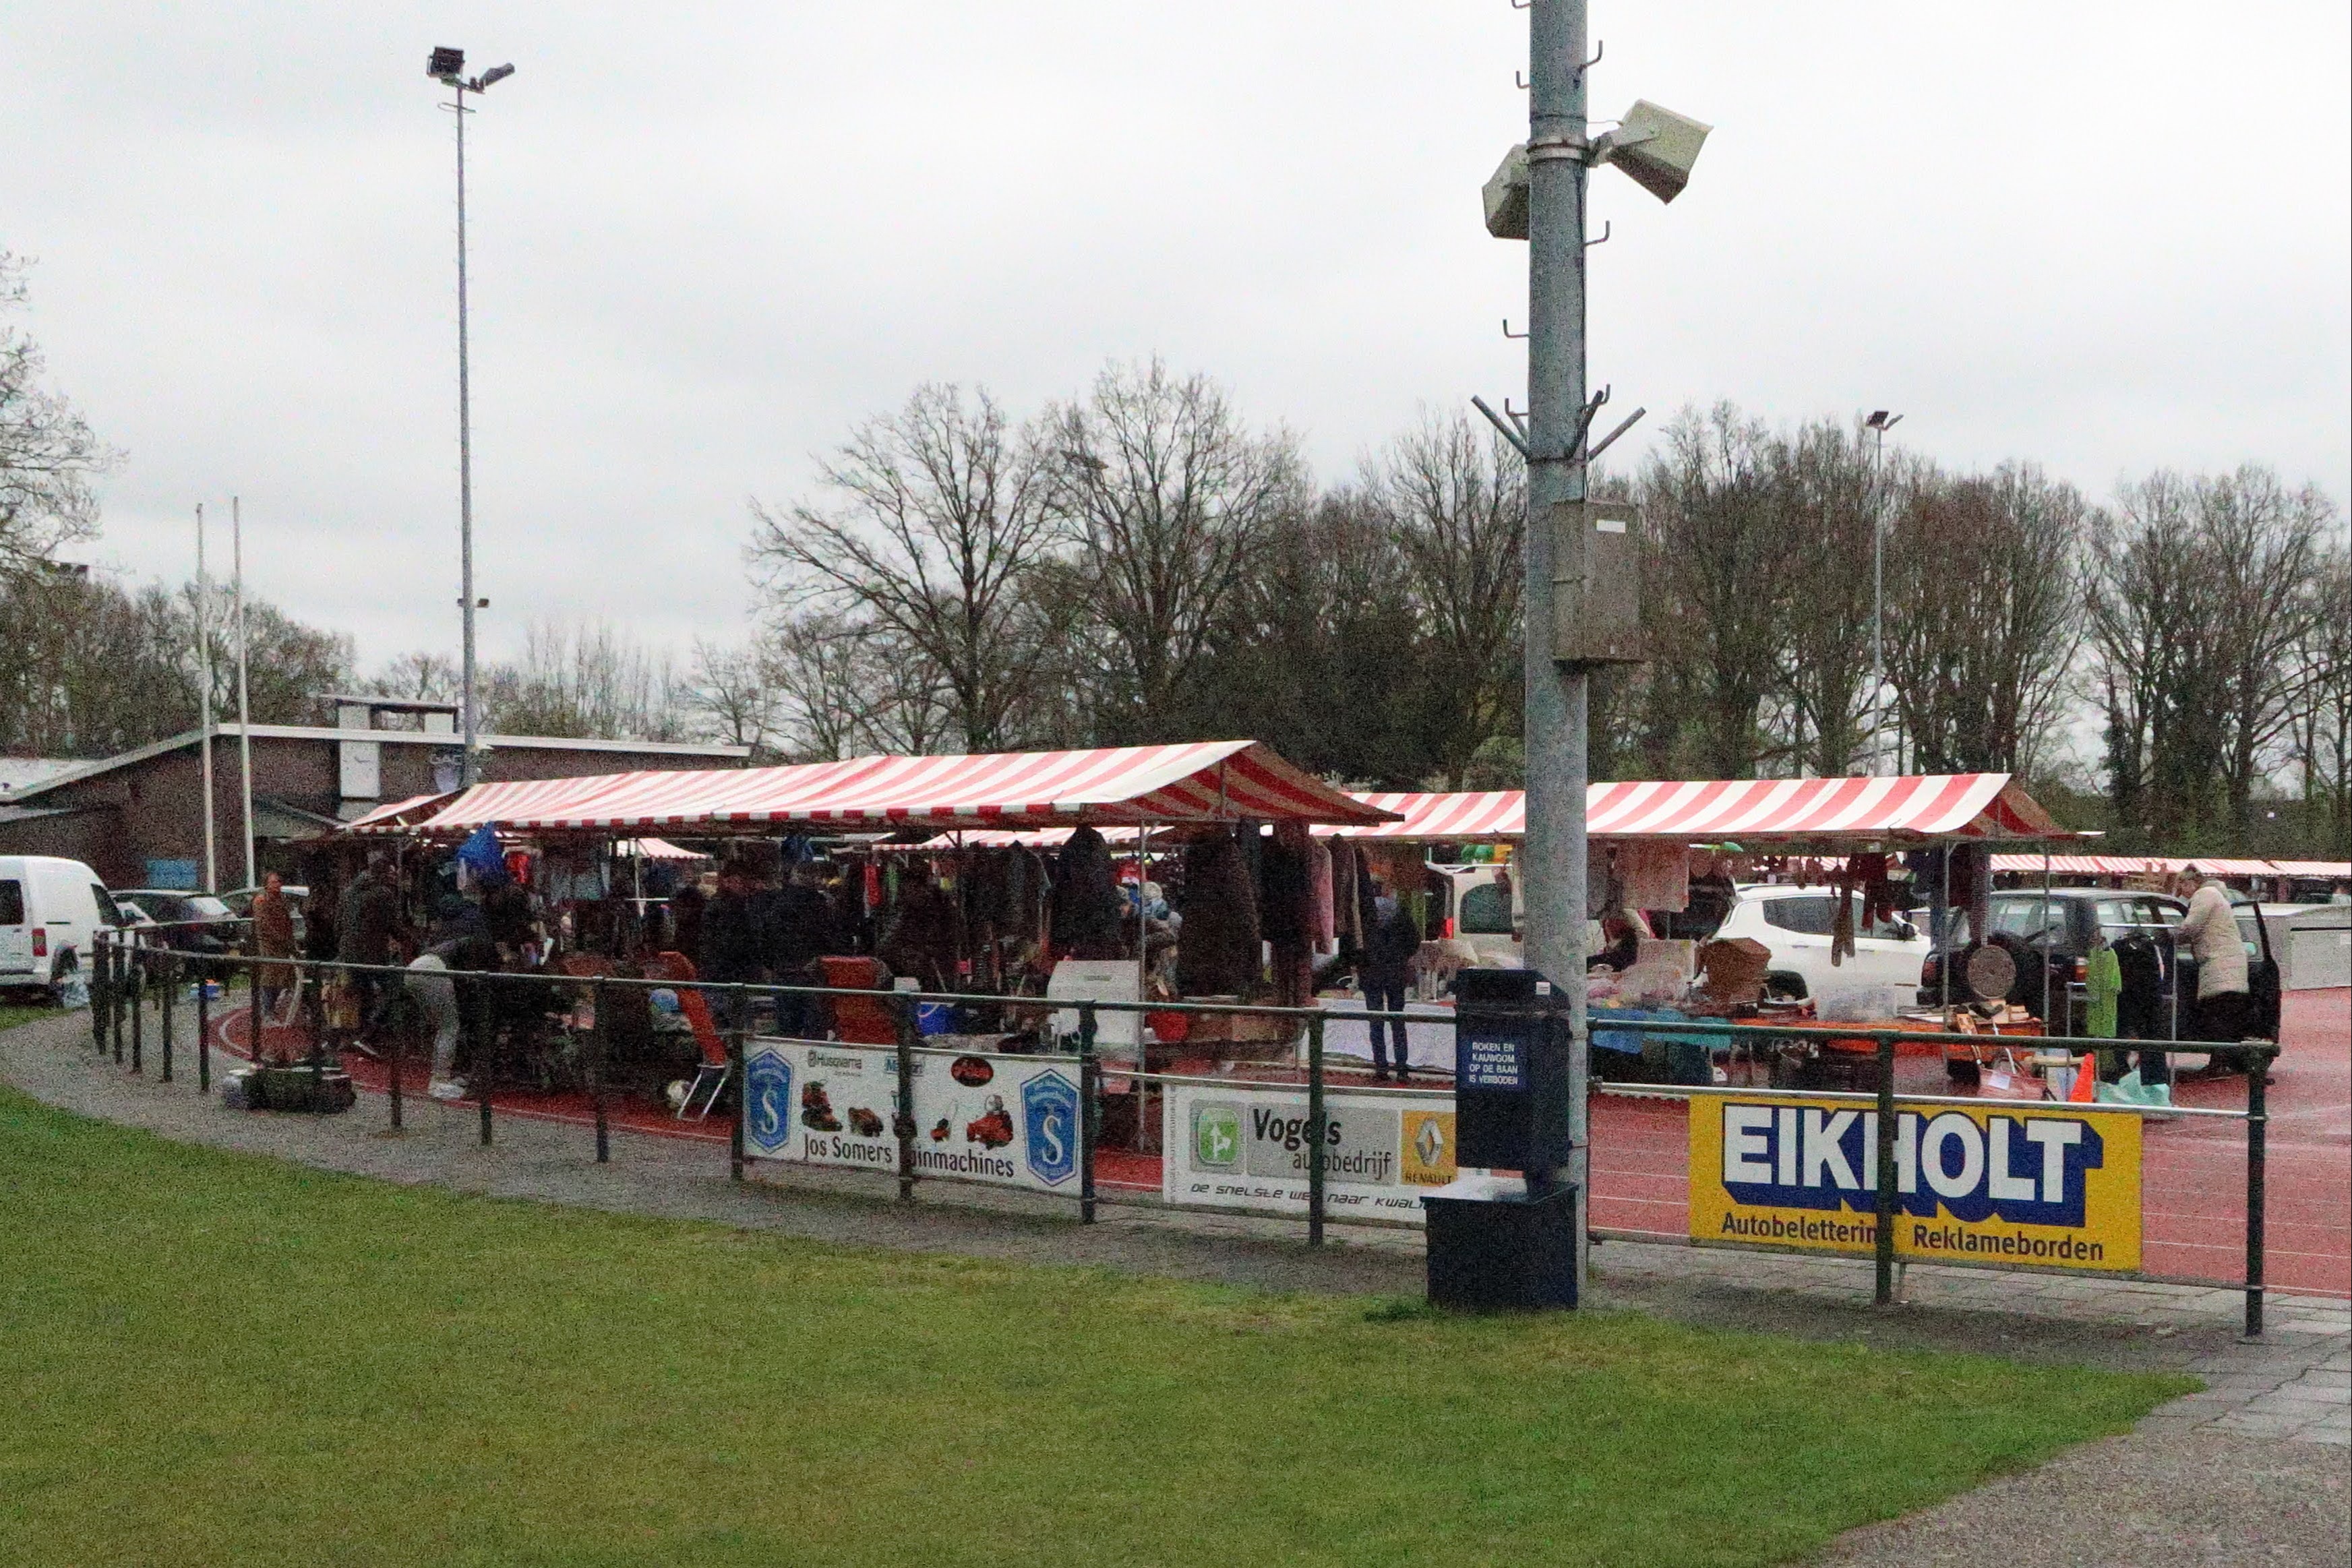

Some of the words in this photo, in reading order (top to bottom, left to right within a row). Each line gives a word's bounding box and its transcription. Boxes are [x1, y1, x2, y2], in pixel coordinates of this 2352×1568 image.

[1472, 1042, 1501, 1052] ROKEN
[1503, 1043, 1515, 1052] EN
[1472, 1052, 1515, 1063] KAUWGOM
[1469, 1063, 1480, 1073] OP
[1483, 1064, 1494, 1073] DE
[1497, 1064, 1518, 1075] BAAN
[1469, 1074, 1476, 1083] IS
[1479, 1075, 1518, 1085] VERBODEN
[1253, 1108, 1342, 1151] Voges
[804, 1133, 827, 1160] Jos
[833, 1135, 893, 1164] Somers
[911, 1145, 1015, 1178] uinmachines
[1724, 1103, 2083, 1204] EIKHOLT
[1292, 1149, 1391, 1180] auobedrijf
[1290, 1190, 1310, 1201] we
[1720, 1212, 1877, 1244] Autobeletterin
[1913, 1224, 2104, 1261] Reklameborden
